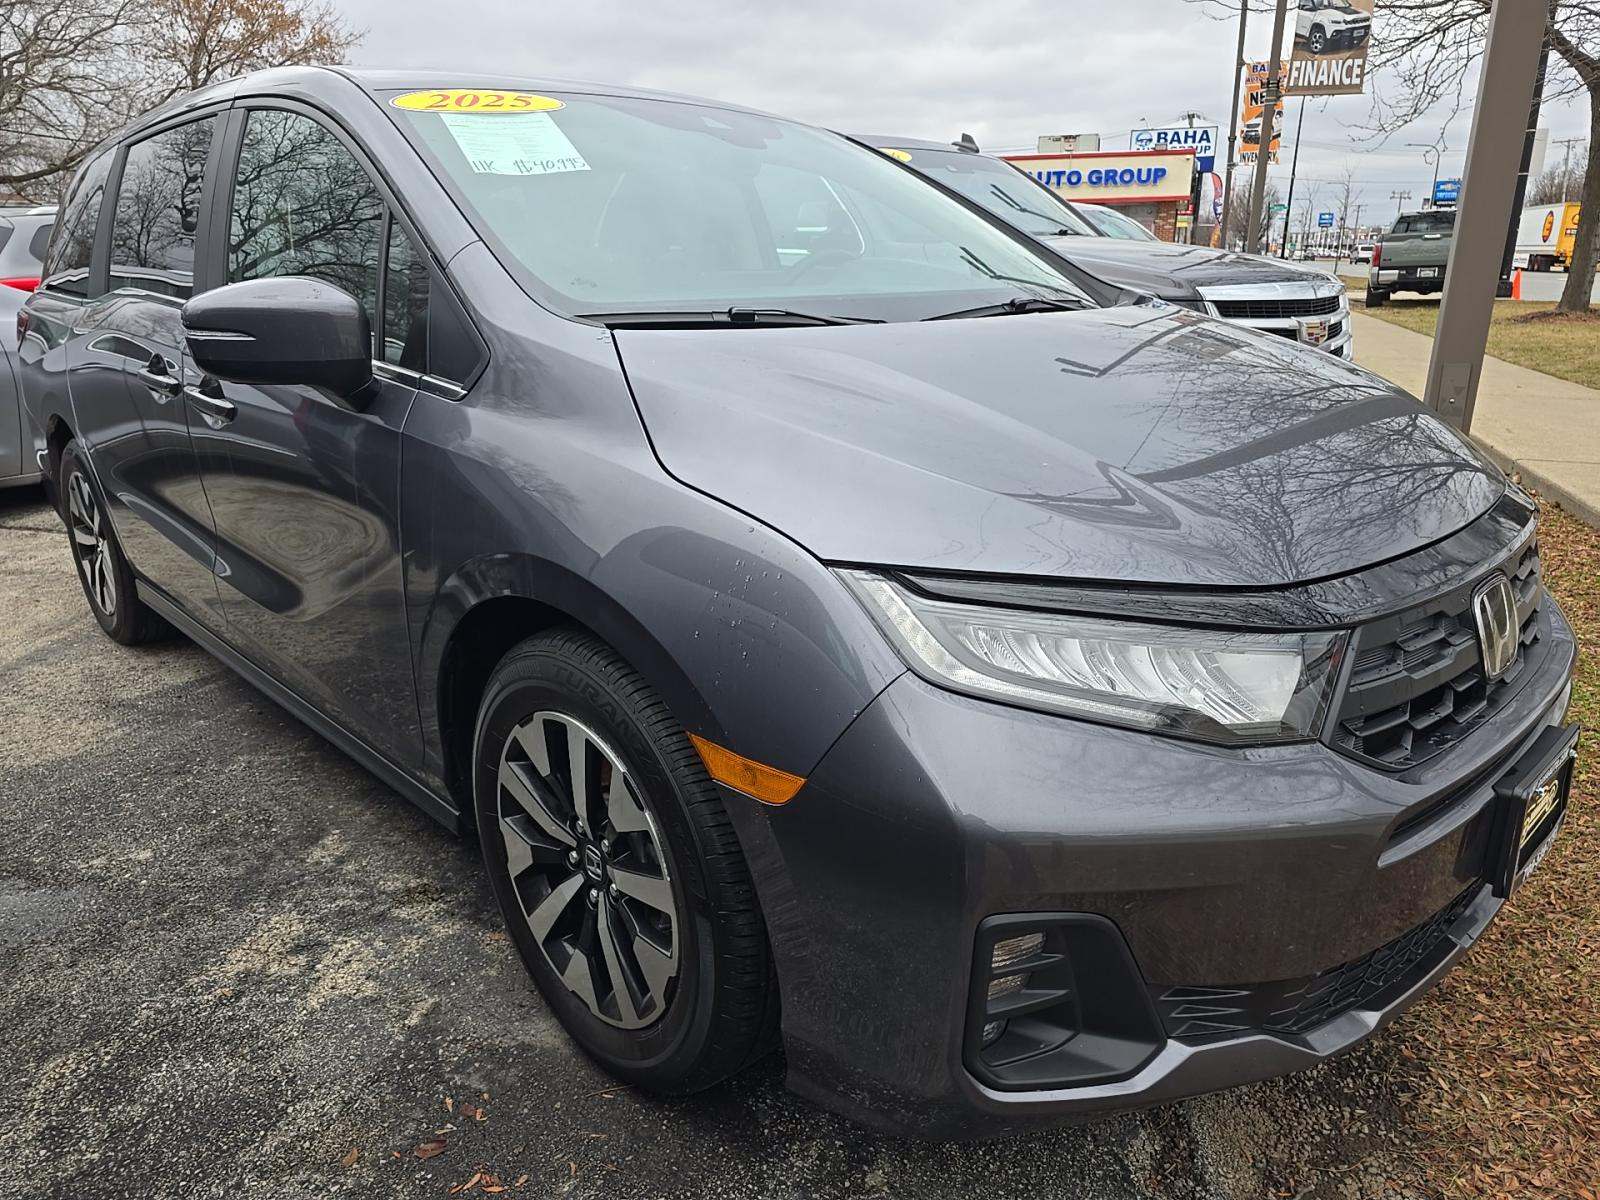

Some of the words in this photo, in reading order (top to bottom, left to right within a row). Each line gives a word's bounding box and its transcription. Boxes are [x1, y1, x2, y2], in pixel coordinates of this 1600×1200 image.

[1290, 58, 1363, 87] FINANCE
[425, 93, 533, 109] 2025
[1249, 91, 1267, 106] NE
[1157, 130, 1211, 145] BAHA
[1028, 169, 1082, 188] UTO
[1087, 167, 1167, 187] GROUP
